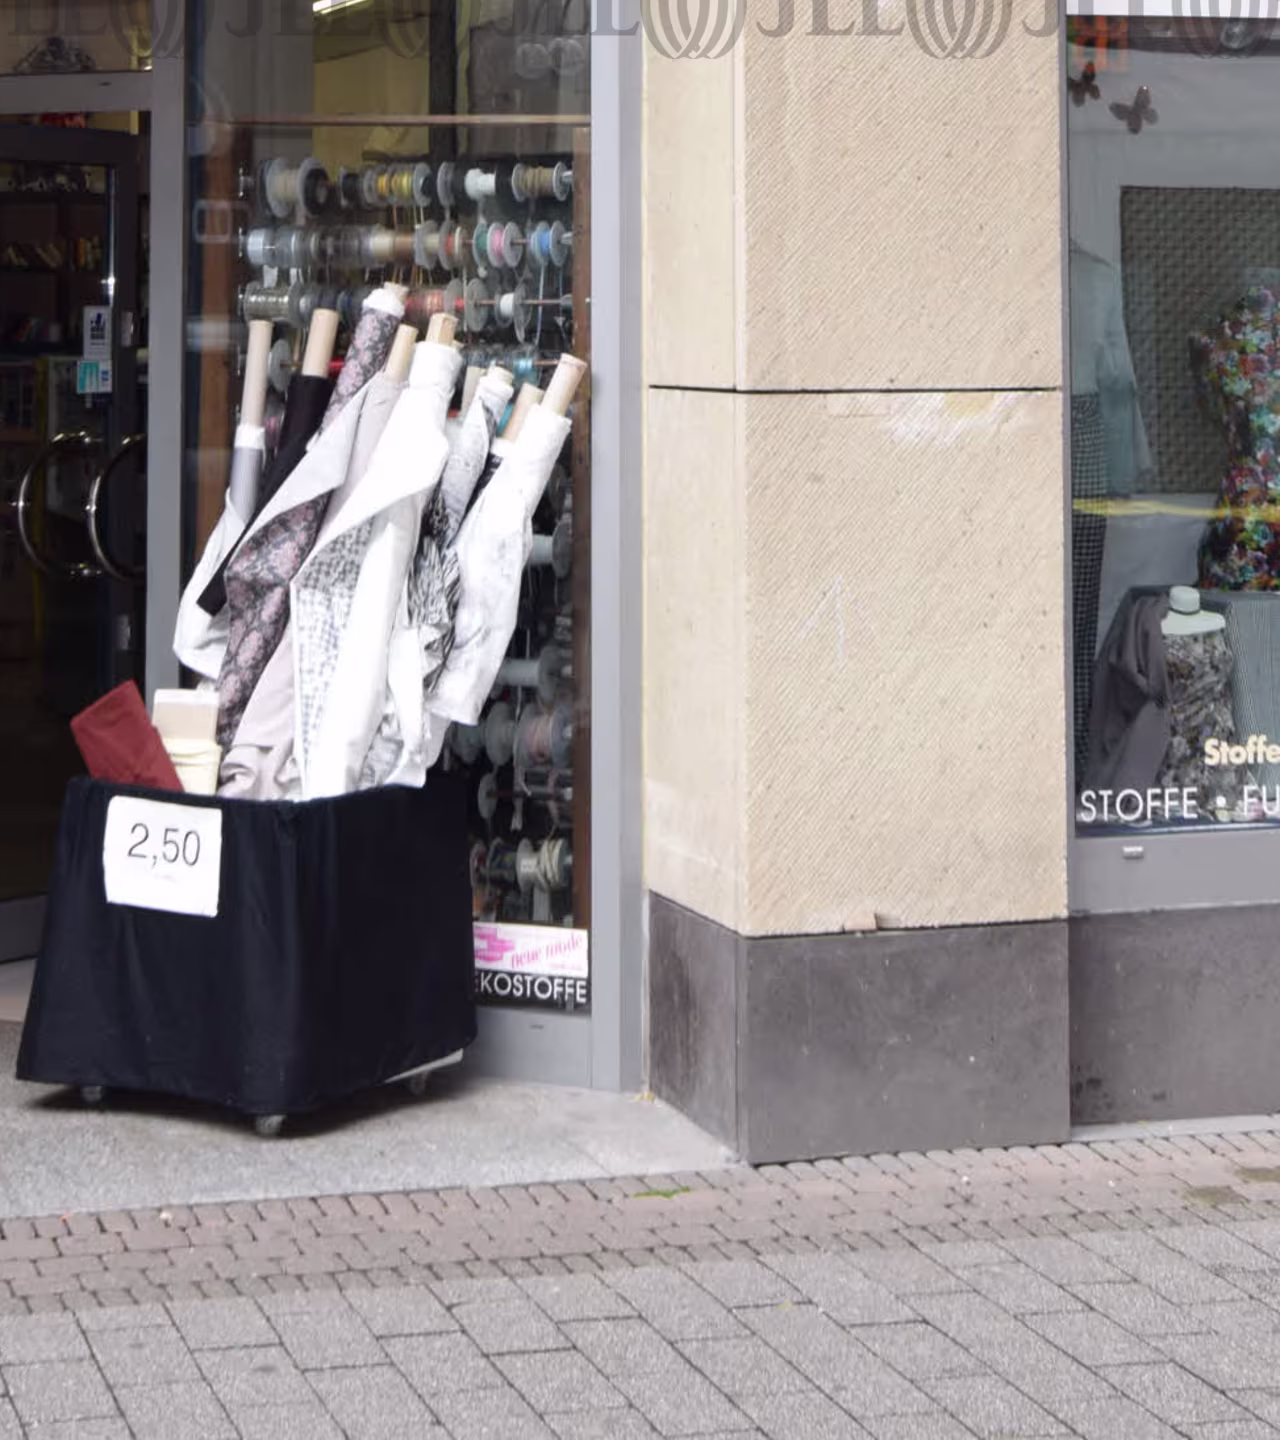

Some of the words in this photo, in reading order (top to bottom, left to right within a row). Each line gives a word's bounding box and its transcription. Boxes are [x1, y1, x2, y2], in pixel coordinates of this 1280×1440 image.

[1080, 786, 1198, 822] STOFFE
[128, 822, 201, 870] 2,50
[475, 971, 587, 1003] KOSTOFFE
